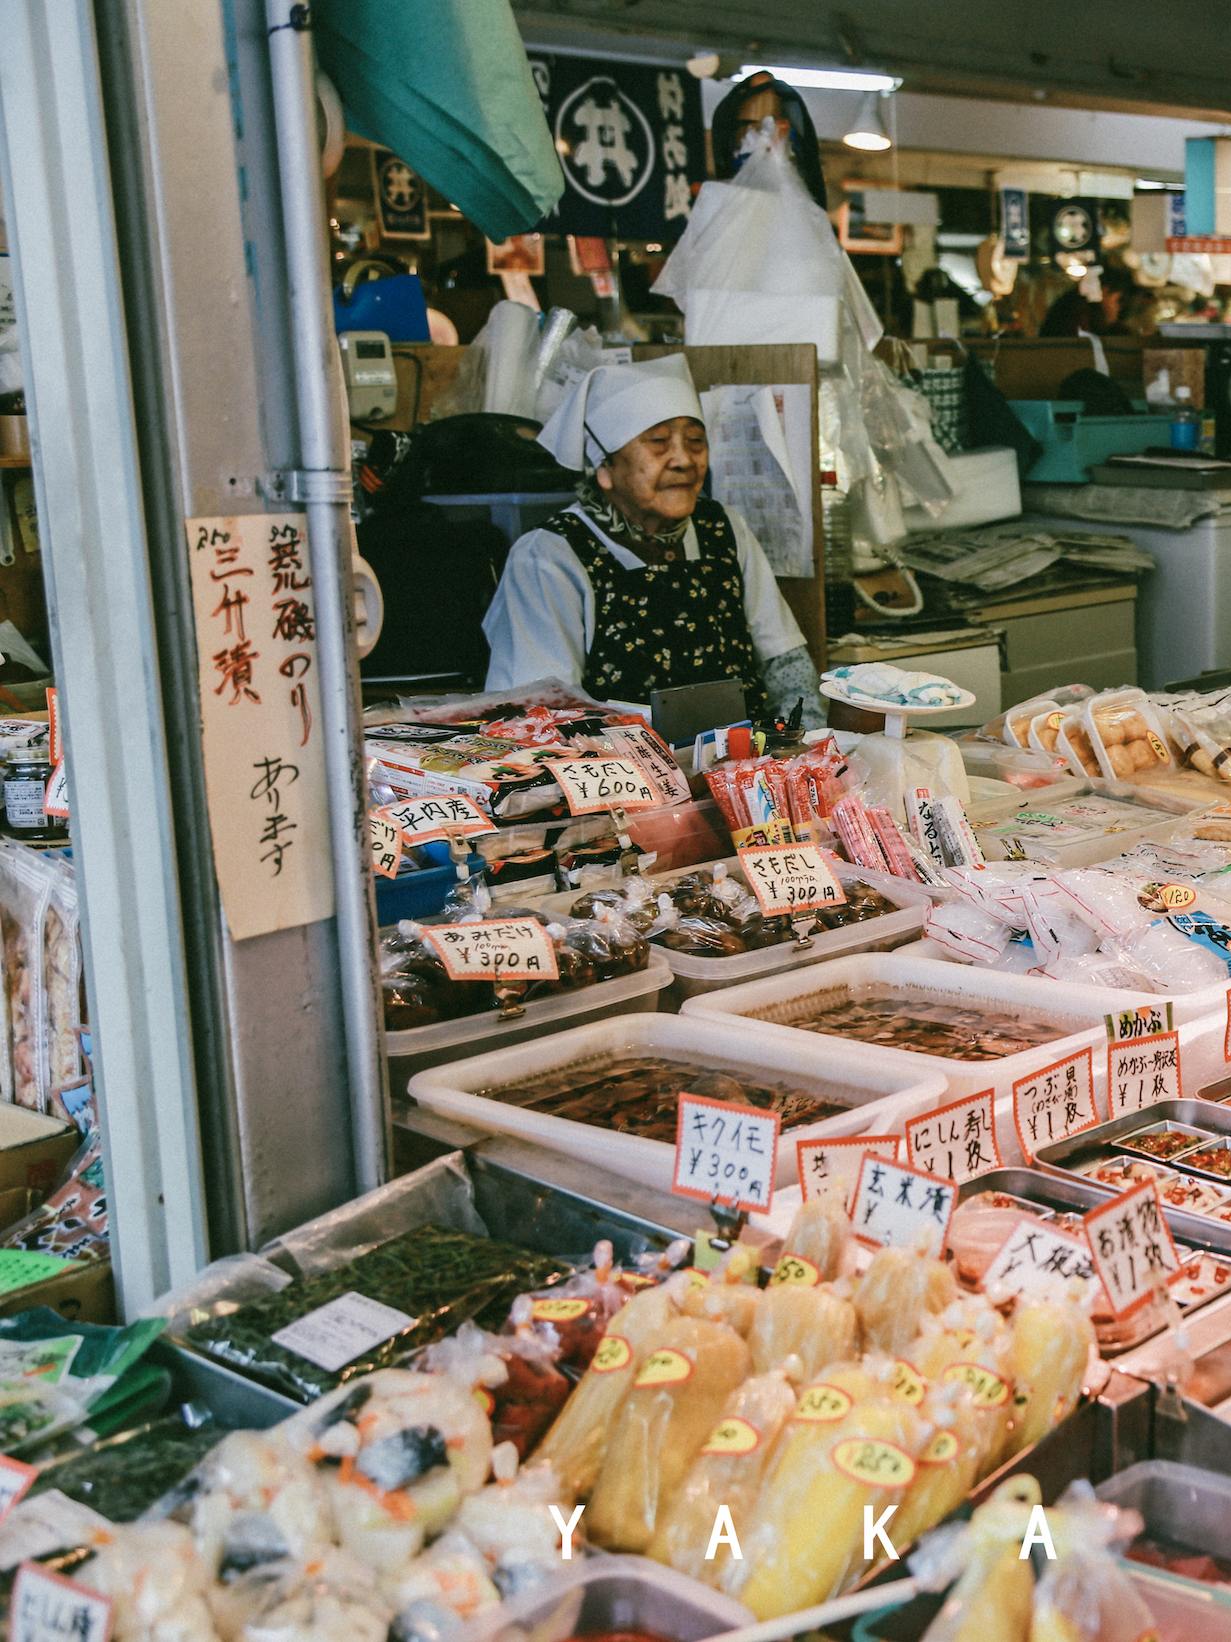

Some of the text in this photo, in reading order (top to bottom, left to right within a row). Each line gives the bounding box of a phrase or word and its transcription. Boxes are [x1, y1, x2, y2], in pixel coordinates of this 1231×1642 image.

[562, 761, 634, 780] さもだし
[575, 778, 653, 801] ¥600円
[251, 756, 299, 877] あります
[392, 797, 480, 831] 平内産
[752, 853, 815, 878] さもだし
[764, 880, 836, 902] ¥300円
[443, 925, 533, 943] あみだけ
[455, 946, 541, 971] ¥300円
[1119, 1010, 1161, 1039] めかぶ
[1023, 1066, 1076, 1099] つぶ貝
[1118, 1073, 1169, 1108] ¥1枚
[693, 1111, 764, 1154] キクイモ
[914, 1107, 992, 1152] にしん寿し
[1027, 1102, 1085, 1143] ¥1枚
[689, 1148, 764, 1199] ¥300円
